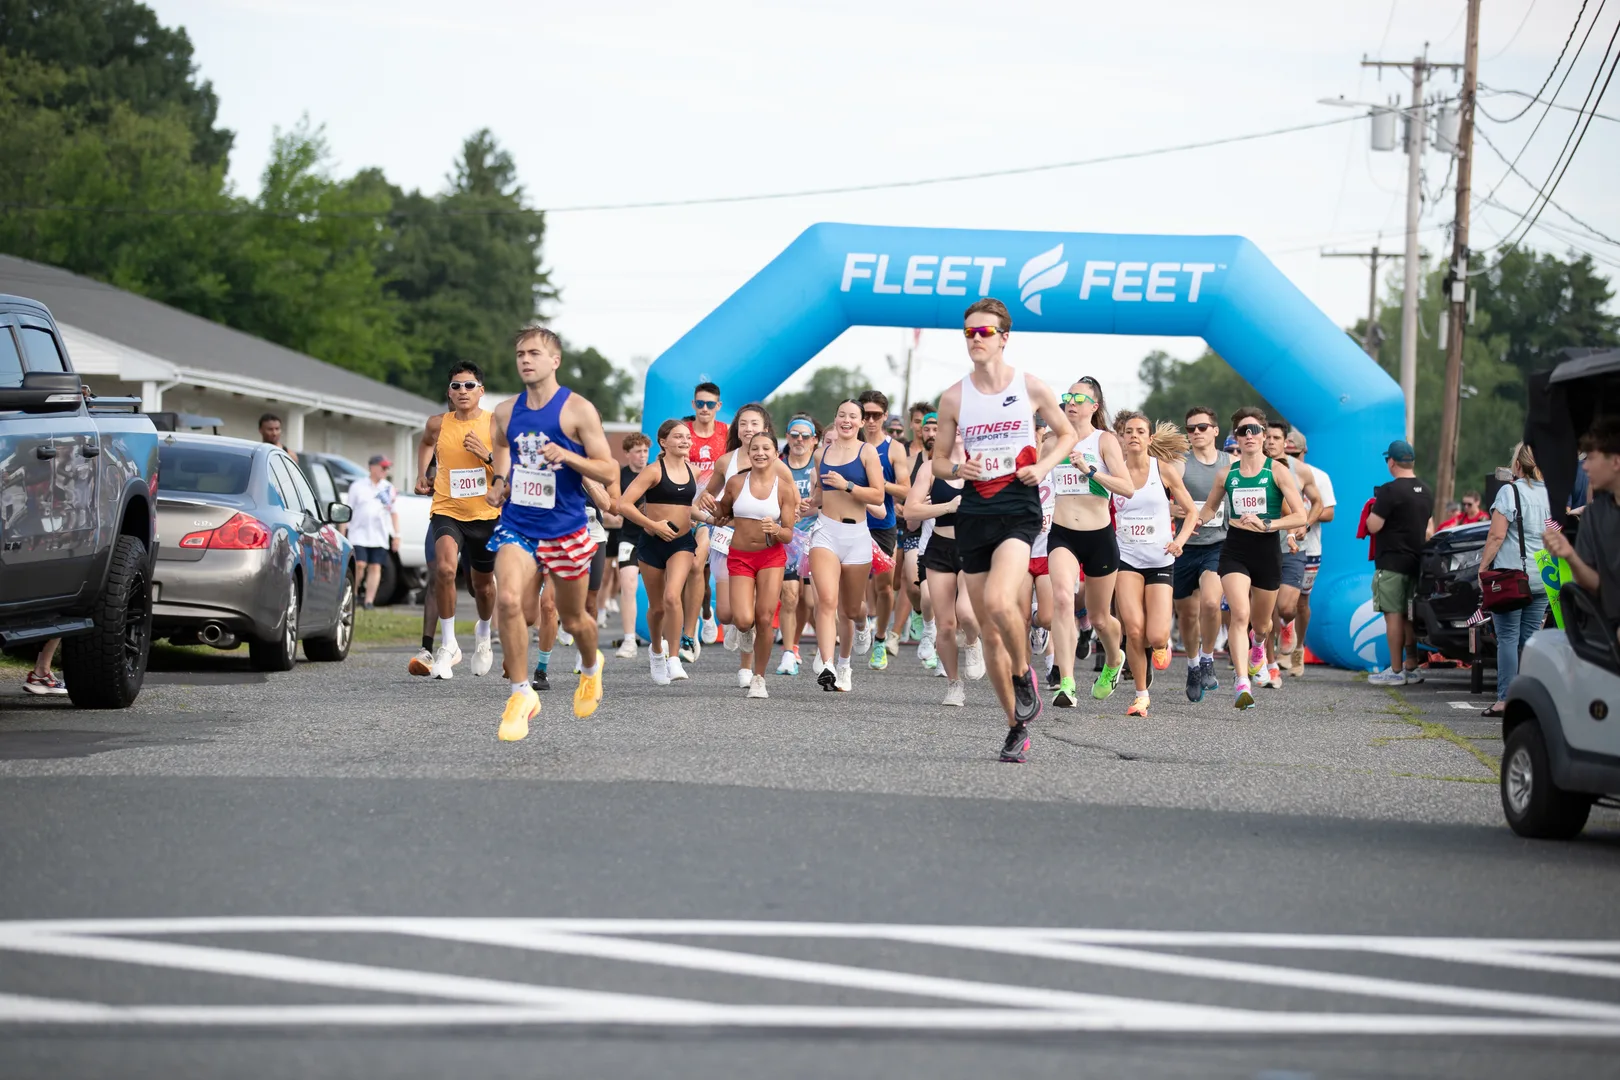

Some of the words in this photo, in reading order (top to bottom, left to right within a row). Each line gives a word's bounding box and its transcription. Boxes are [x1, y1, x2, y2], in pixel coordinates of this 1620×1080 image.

[840, 253, 1006, 297] FLEET
[1079, 260, 1216, 303] FEET
[965, 420, 1022, 437] FITNESS
[976, 432, 1009, 441] SPORTS
[985, 457, 999, 471] 64
[460, 478, 477, 489] 201
[1063, 473, 1078, 485] 151
[523, 481, 542, 496] 120
[1241, 496, 1257, 507] 168
[1130, 524, 1146, 536] 122
[714, 532, 728, 545] 221
